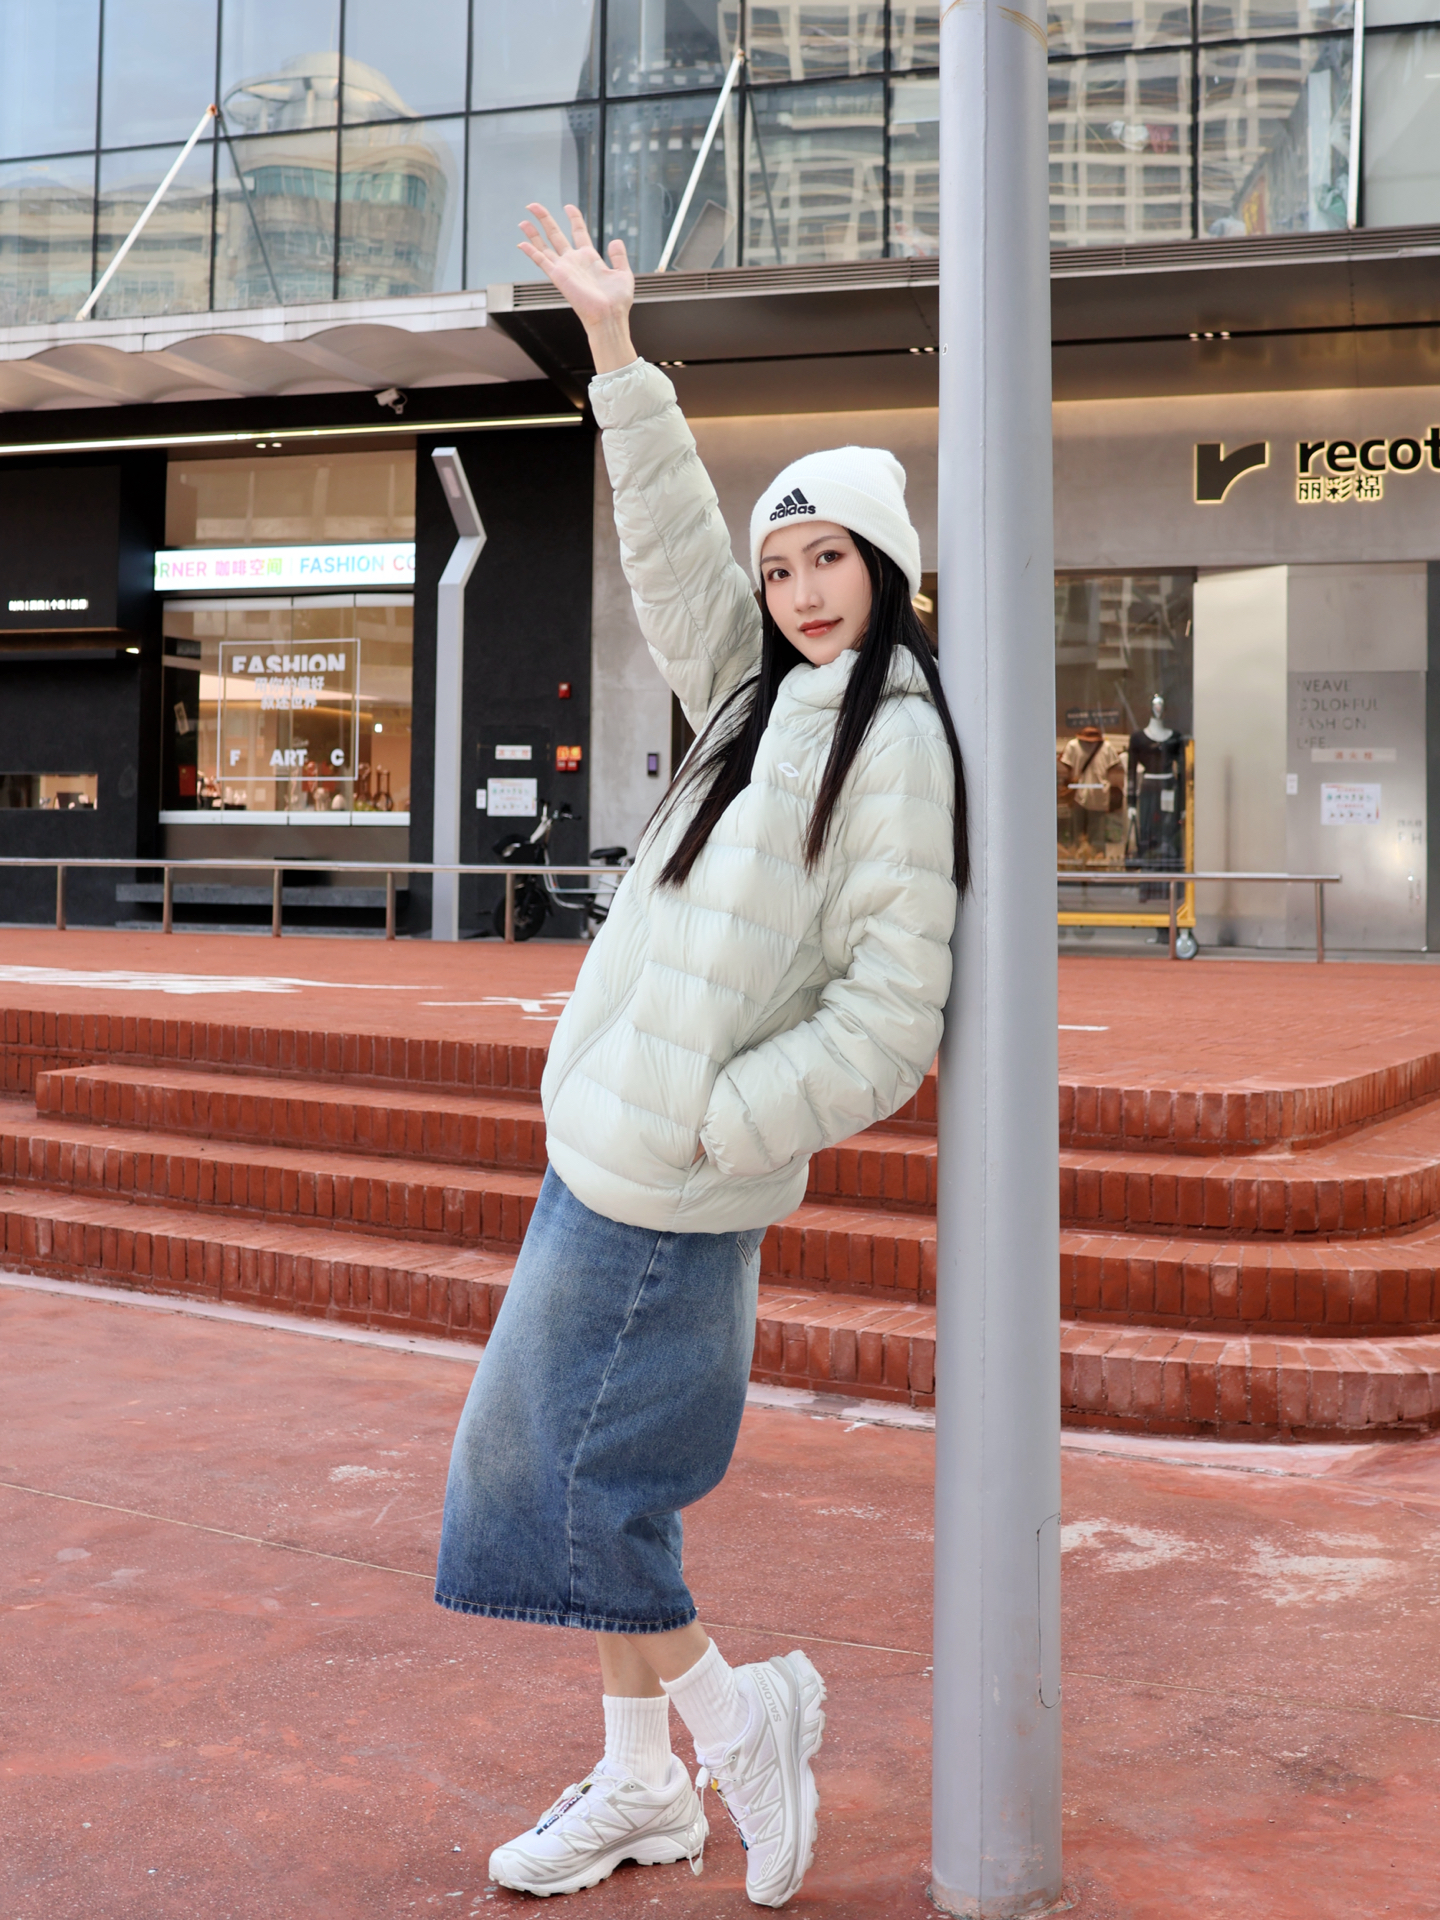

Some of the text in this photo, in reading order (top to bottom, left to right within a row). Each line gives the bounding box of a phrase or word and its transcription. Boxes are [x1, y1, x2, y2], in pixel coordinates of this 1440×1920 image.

[1296, 475, 1383, 503] 丽彩棉
[769, 503, 816, 521] adidas
[154, 561, 208, 579] RNER
[215, 556, 283, 578] 咖啡空间
[299, 554, 385, 575] FASHION
[232, 653, 346, 674] FASHION
[1297, 716, 1367, 731] FASHON
[229, 748, 345, 767] F ART C
[750, 1665, 782, 1723] SALOMON
